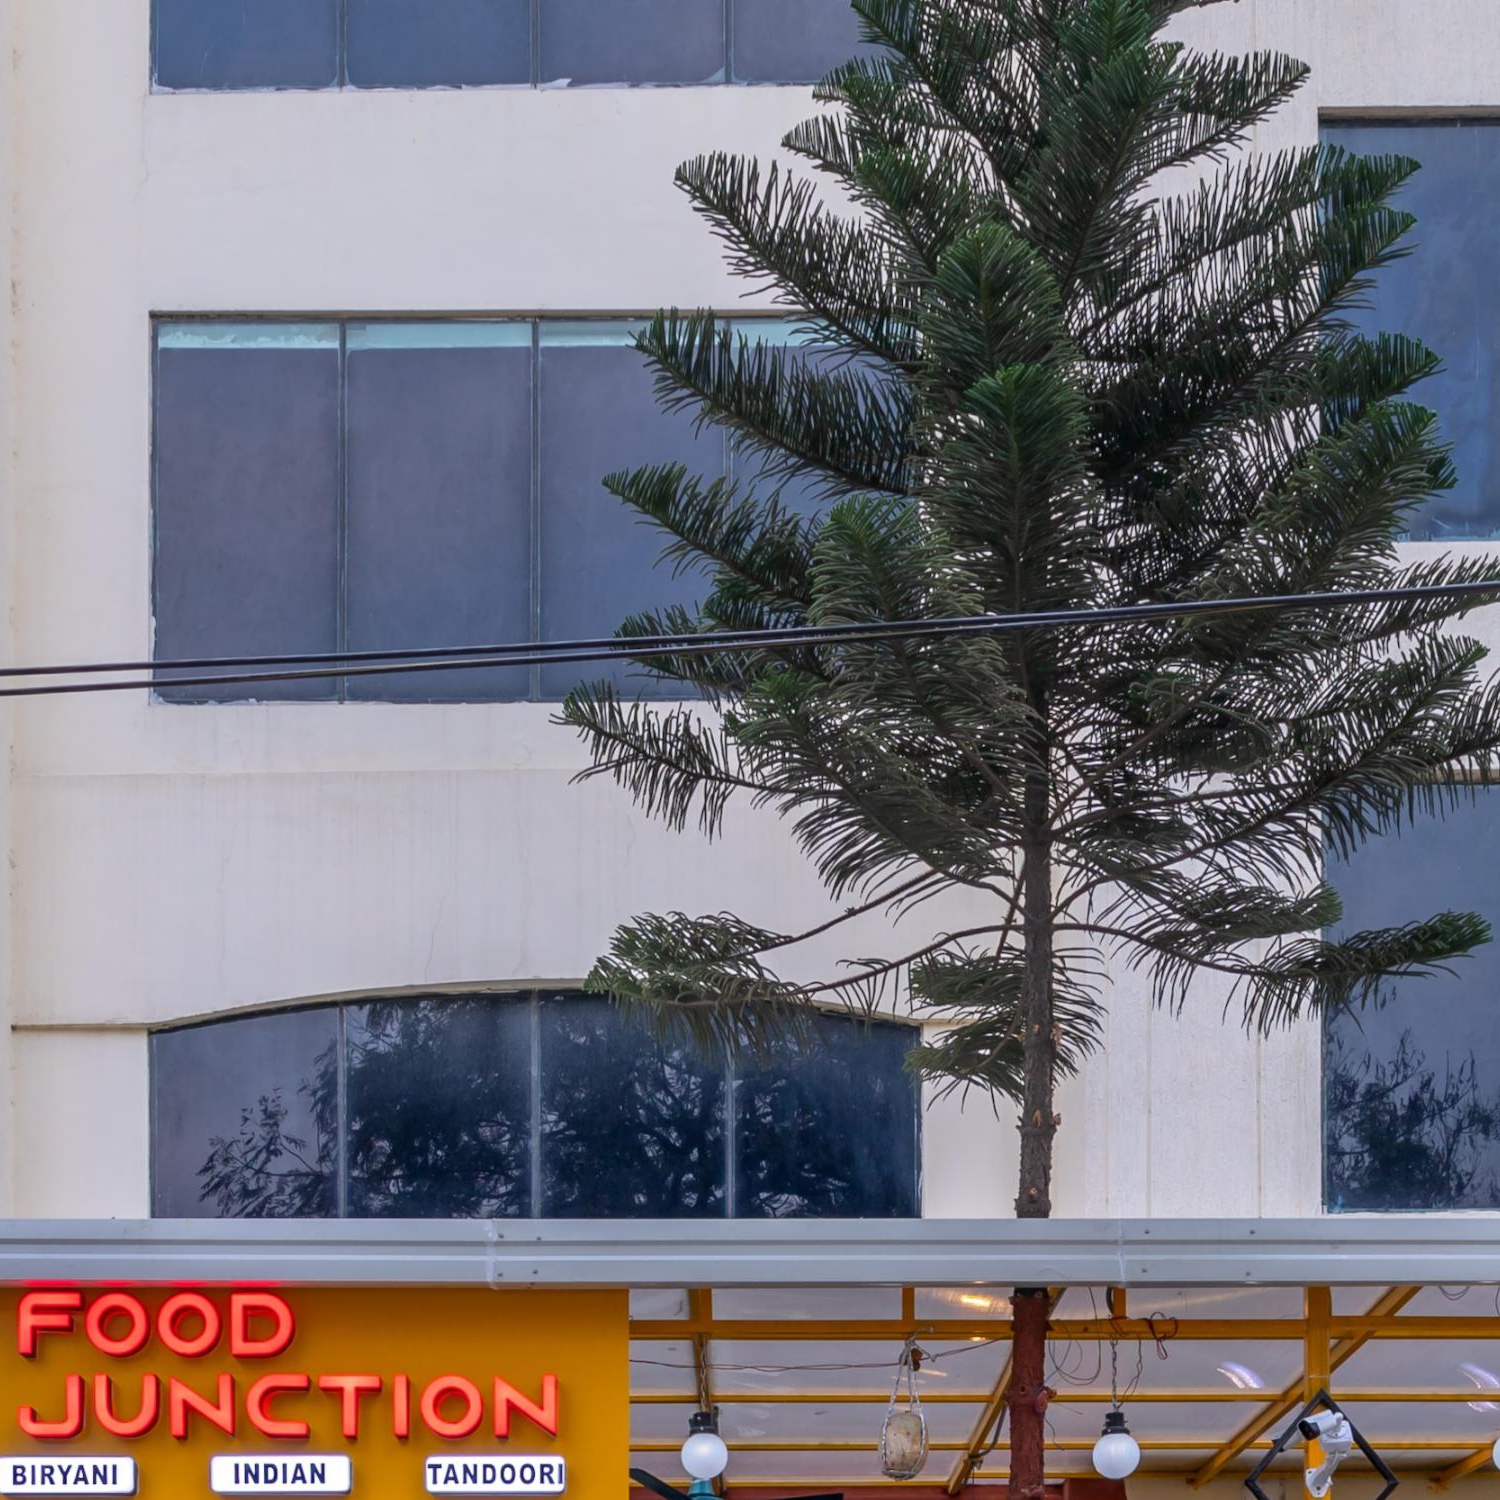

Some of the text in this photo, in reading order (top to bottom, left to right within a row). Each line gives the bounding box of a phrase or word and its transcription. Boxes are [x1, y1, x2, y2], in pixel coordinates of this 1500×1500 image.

[17, 1292, 296, 1358] FOOD
[17, 1373, 558, 1440] JUNCTION
[12, 1464, 118, 1486] BIRYANI
[233, 1463, 326, 1485] INDIAN
[427, 1463, 564, 1485] TANDOORI
